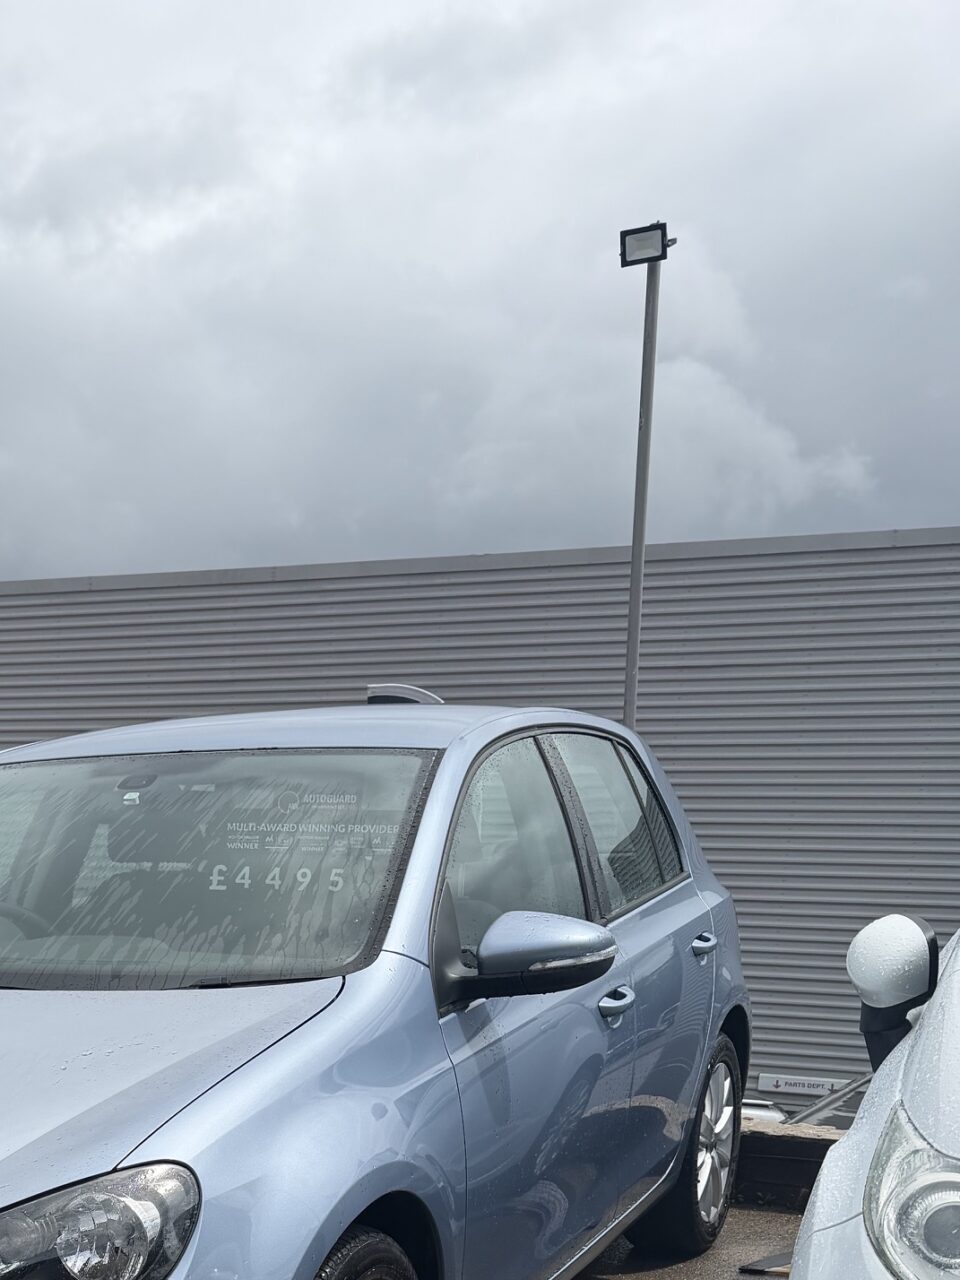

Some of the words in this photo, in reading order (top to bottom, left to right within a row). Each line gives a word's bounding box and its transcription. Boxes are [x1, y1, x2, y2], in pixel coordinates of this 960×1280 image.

[303, 794, 357, 804] AUTOGUARD
[227, 822, 297, 833] MULTI-AWARD
[298, 823, 346, 833] WINNING
[784, 1081, 806, 1089] PARTS
[807, 1082, 826, 1090] DEPT.
